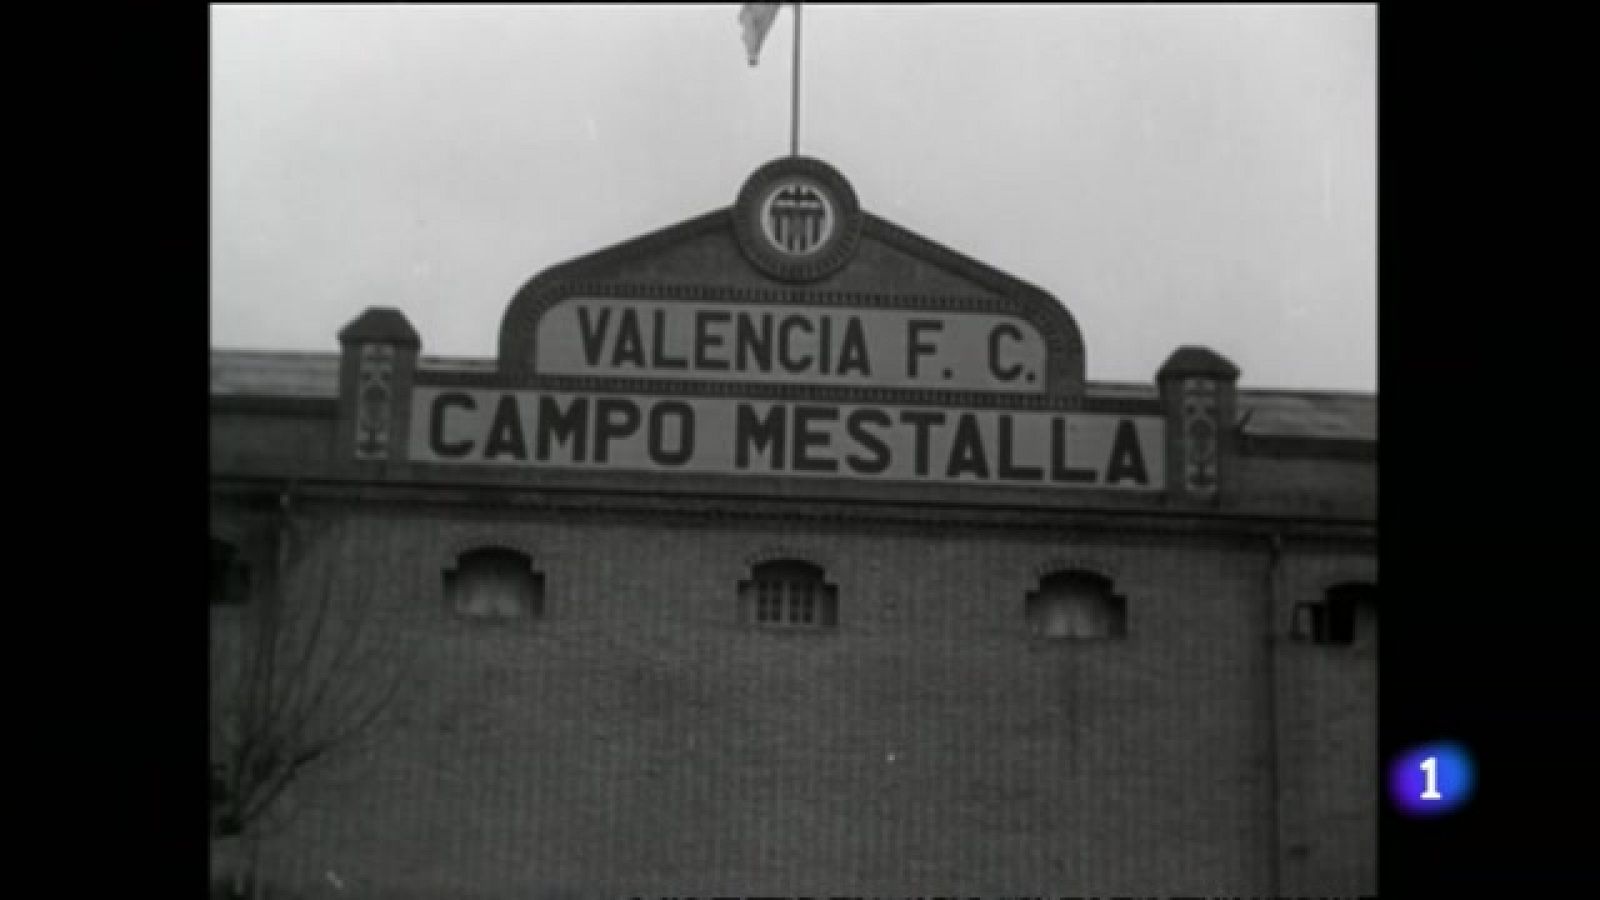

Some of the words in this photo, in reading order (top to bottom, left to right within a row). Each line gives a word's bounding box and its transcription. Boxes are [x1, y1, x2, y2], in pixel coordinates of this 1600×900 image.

[577, 306, 870, 377] VALENCIA
[906, 320, 954, 380] F.
[987, 324, 1037, 383] C.
[429, 394, 696, 467] CAMPO
[735, 403, 1150, 486] MESTALLA
